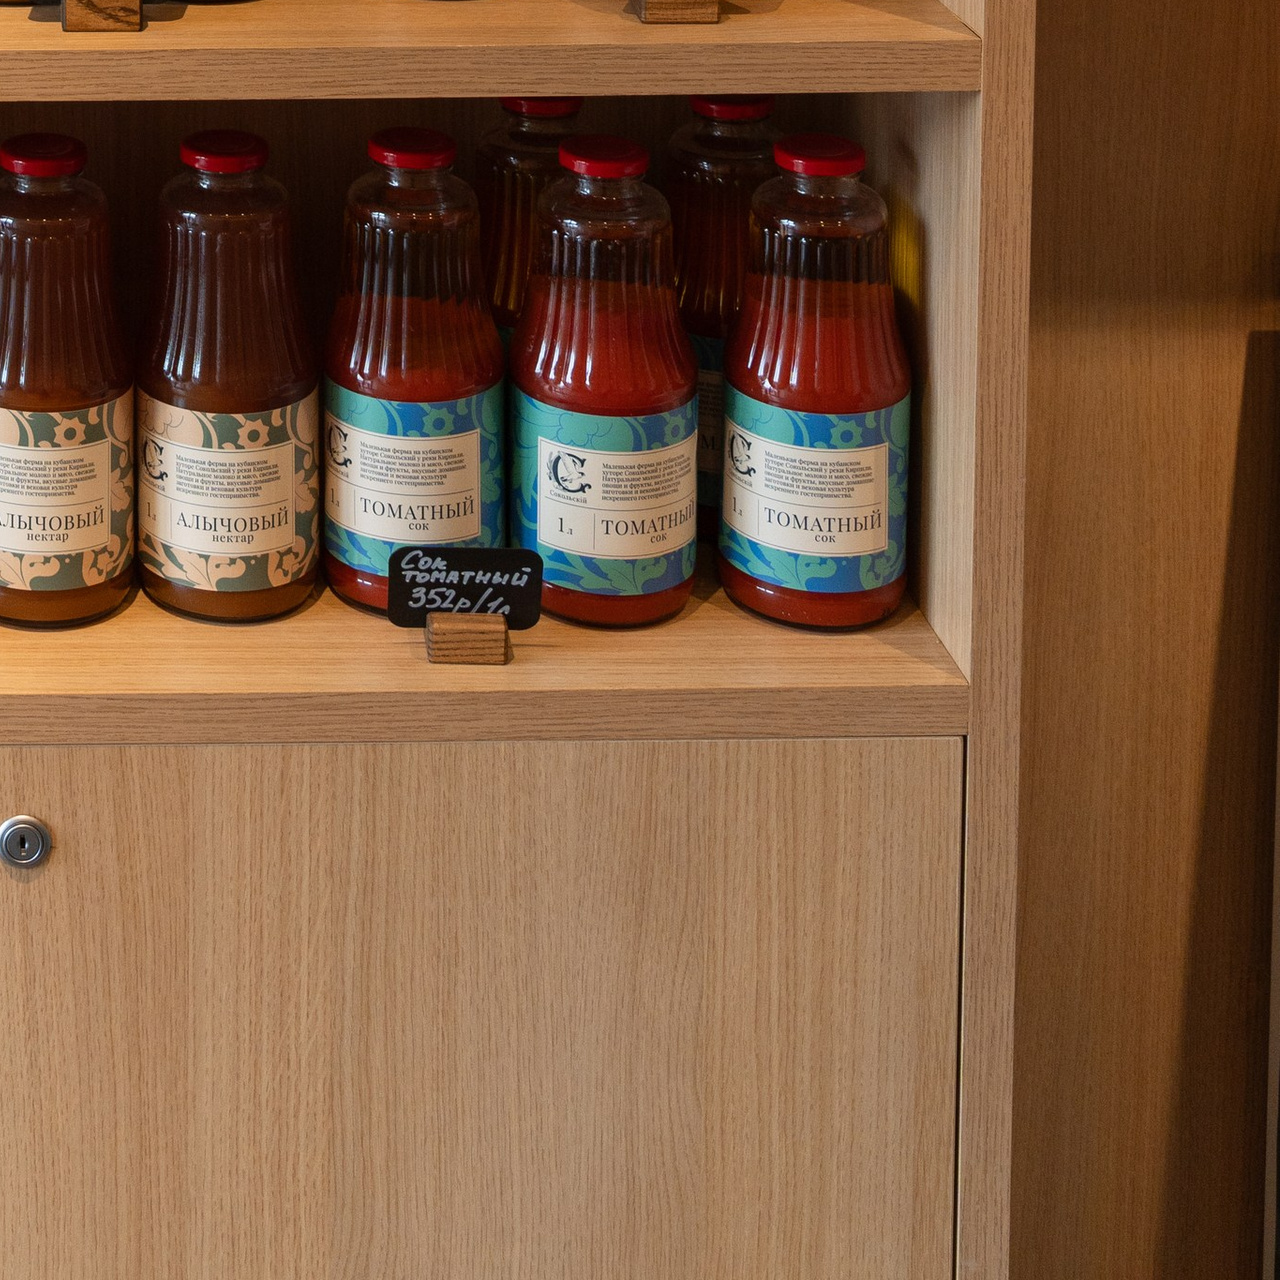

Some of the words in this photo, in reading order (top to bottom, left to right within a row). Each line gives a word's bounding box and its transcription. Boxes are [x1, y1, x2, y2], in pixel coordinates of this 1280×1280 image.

[176, 507, 289, 533] АЛЫЧОВЫЙ
[360, 494, 474, 521] ТОМАТНЫЙ
[602, 497, 694, 535] ТОМАТНЫЙ
[764, 506, 882, 533] ТОМАТНЫЙ
[408, 520, 429, 531] сок
[402, 567, 532, 586] ТОМАТНЫЙ
